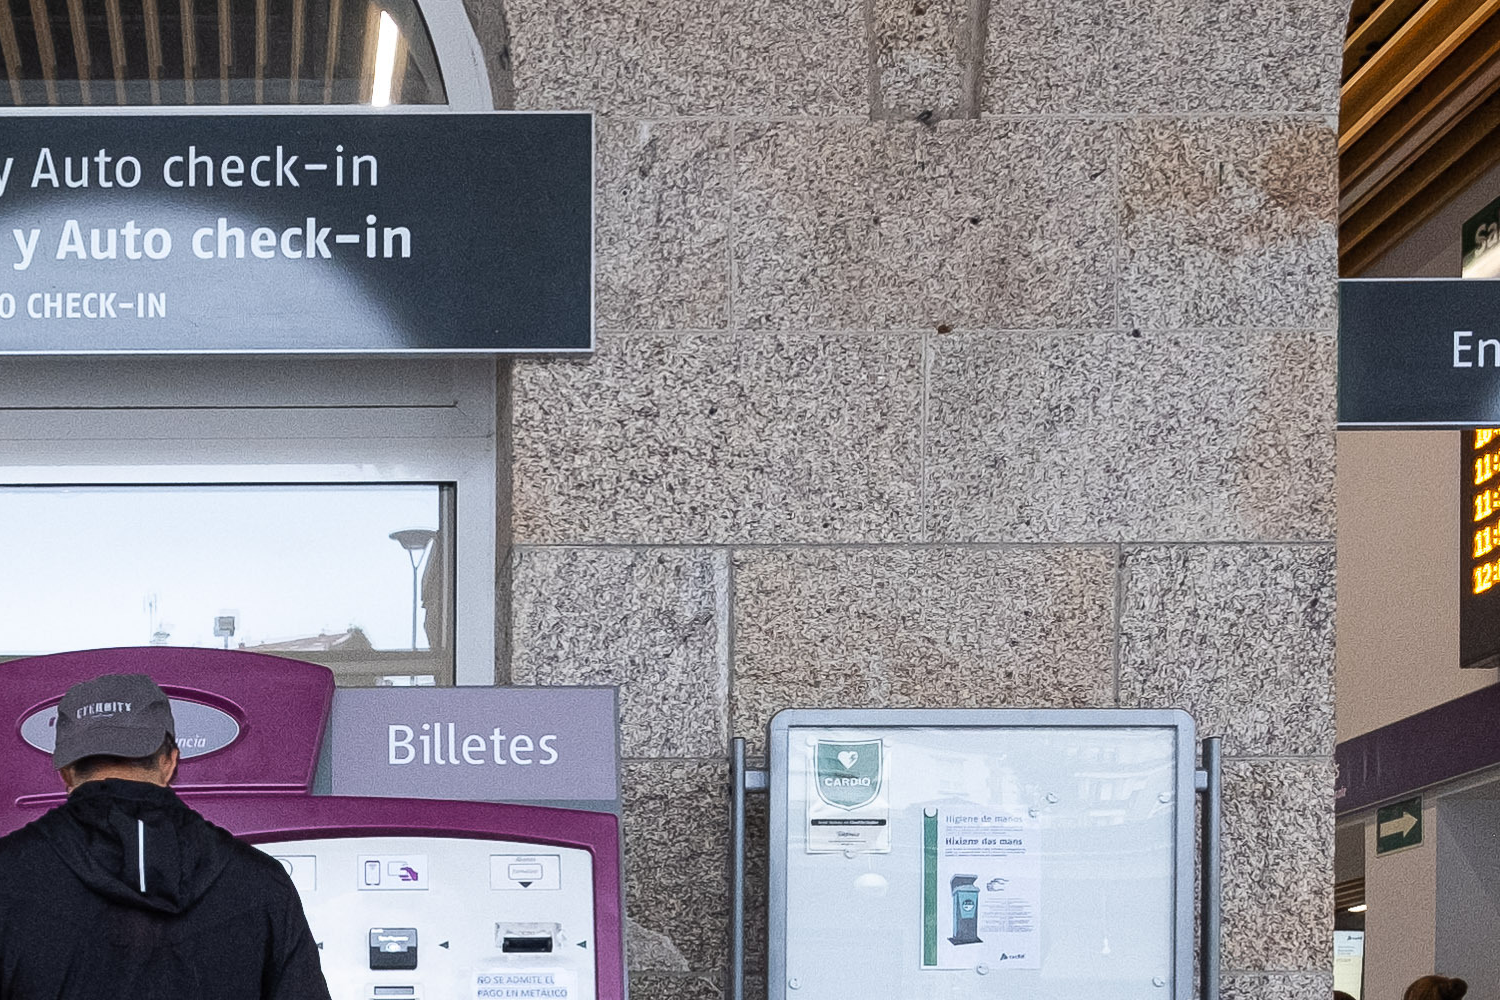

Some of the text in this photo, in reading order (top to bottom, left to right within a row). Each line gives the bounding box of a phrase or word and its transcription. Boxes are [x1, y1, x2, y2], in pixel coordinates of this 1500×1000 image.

[31, 147, 142, 189] Auto
[163, 146, 380, 188] check-in
[12, 228, 41, 271] y
[56, 218, 172, 262] Auto
[191, 215, 413, 261] check-in
[26, 292, 167, 319] CHECK-IN
[387, 723, 559, 766] Billetes
[477, 976, 491, 984] NO
[493, 976, 504, 984] SE
[507, 976, 542, 984] ADMITE
[477, 989, 503, 998] PAGO
